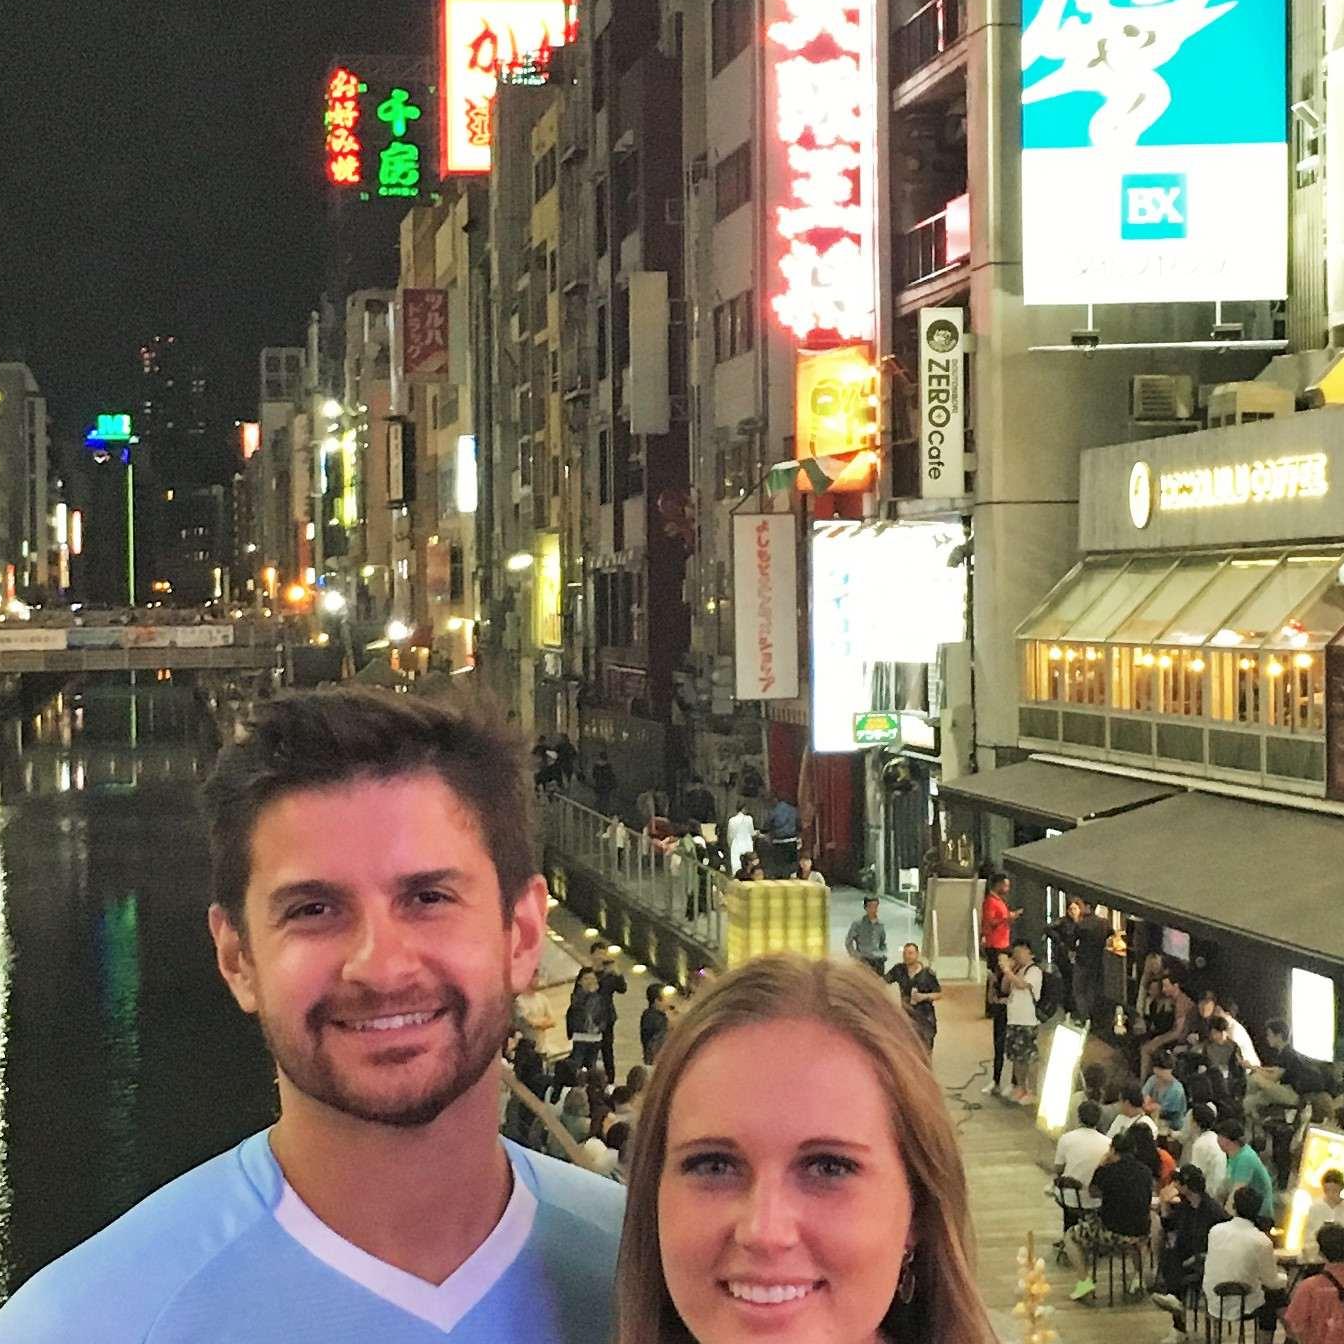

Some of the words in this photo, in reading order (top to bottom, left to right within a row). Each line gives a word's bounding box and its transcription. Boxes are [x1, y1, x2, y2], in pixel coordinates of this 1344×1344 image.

[376, 88, 422, 186] 千房
[1126, 186, 1185, 225] BX
[927, 358, 951, 428] ZERO
